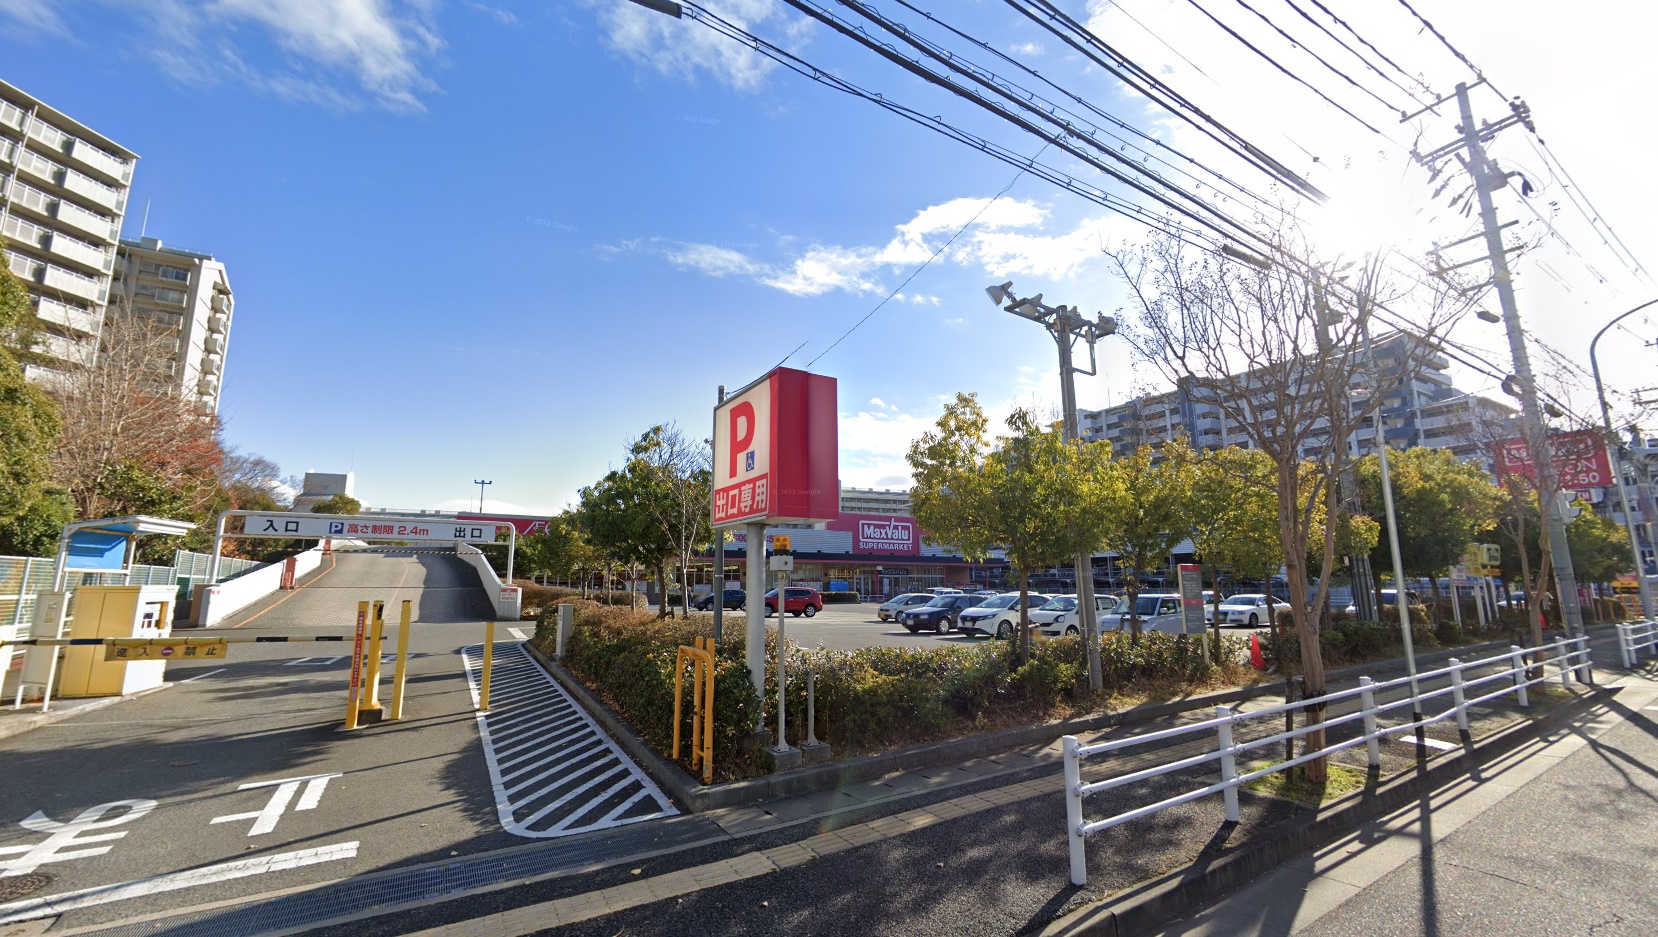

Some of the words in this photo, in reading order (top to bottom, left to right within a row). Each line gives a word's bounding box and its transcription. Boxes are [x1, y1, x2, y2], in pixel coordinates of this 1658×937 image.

[729, 401, 755, 479] P
[715, 478, 767, 519] 出口専用
[262, 519, 300, 533] 入口
[347, 523, 394, 536] 高さ制限
[397, 525, 429, 537] 2.4m
[454, 526, 483, 539] 出口
[863, 518, 909, 540] MaxValu
[859, 542, 912, 550] SUPERMARKET
